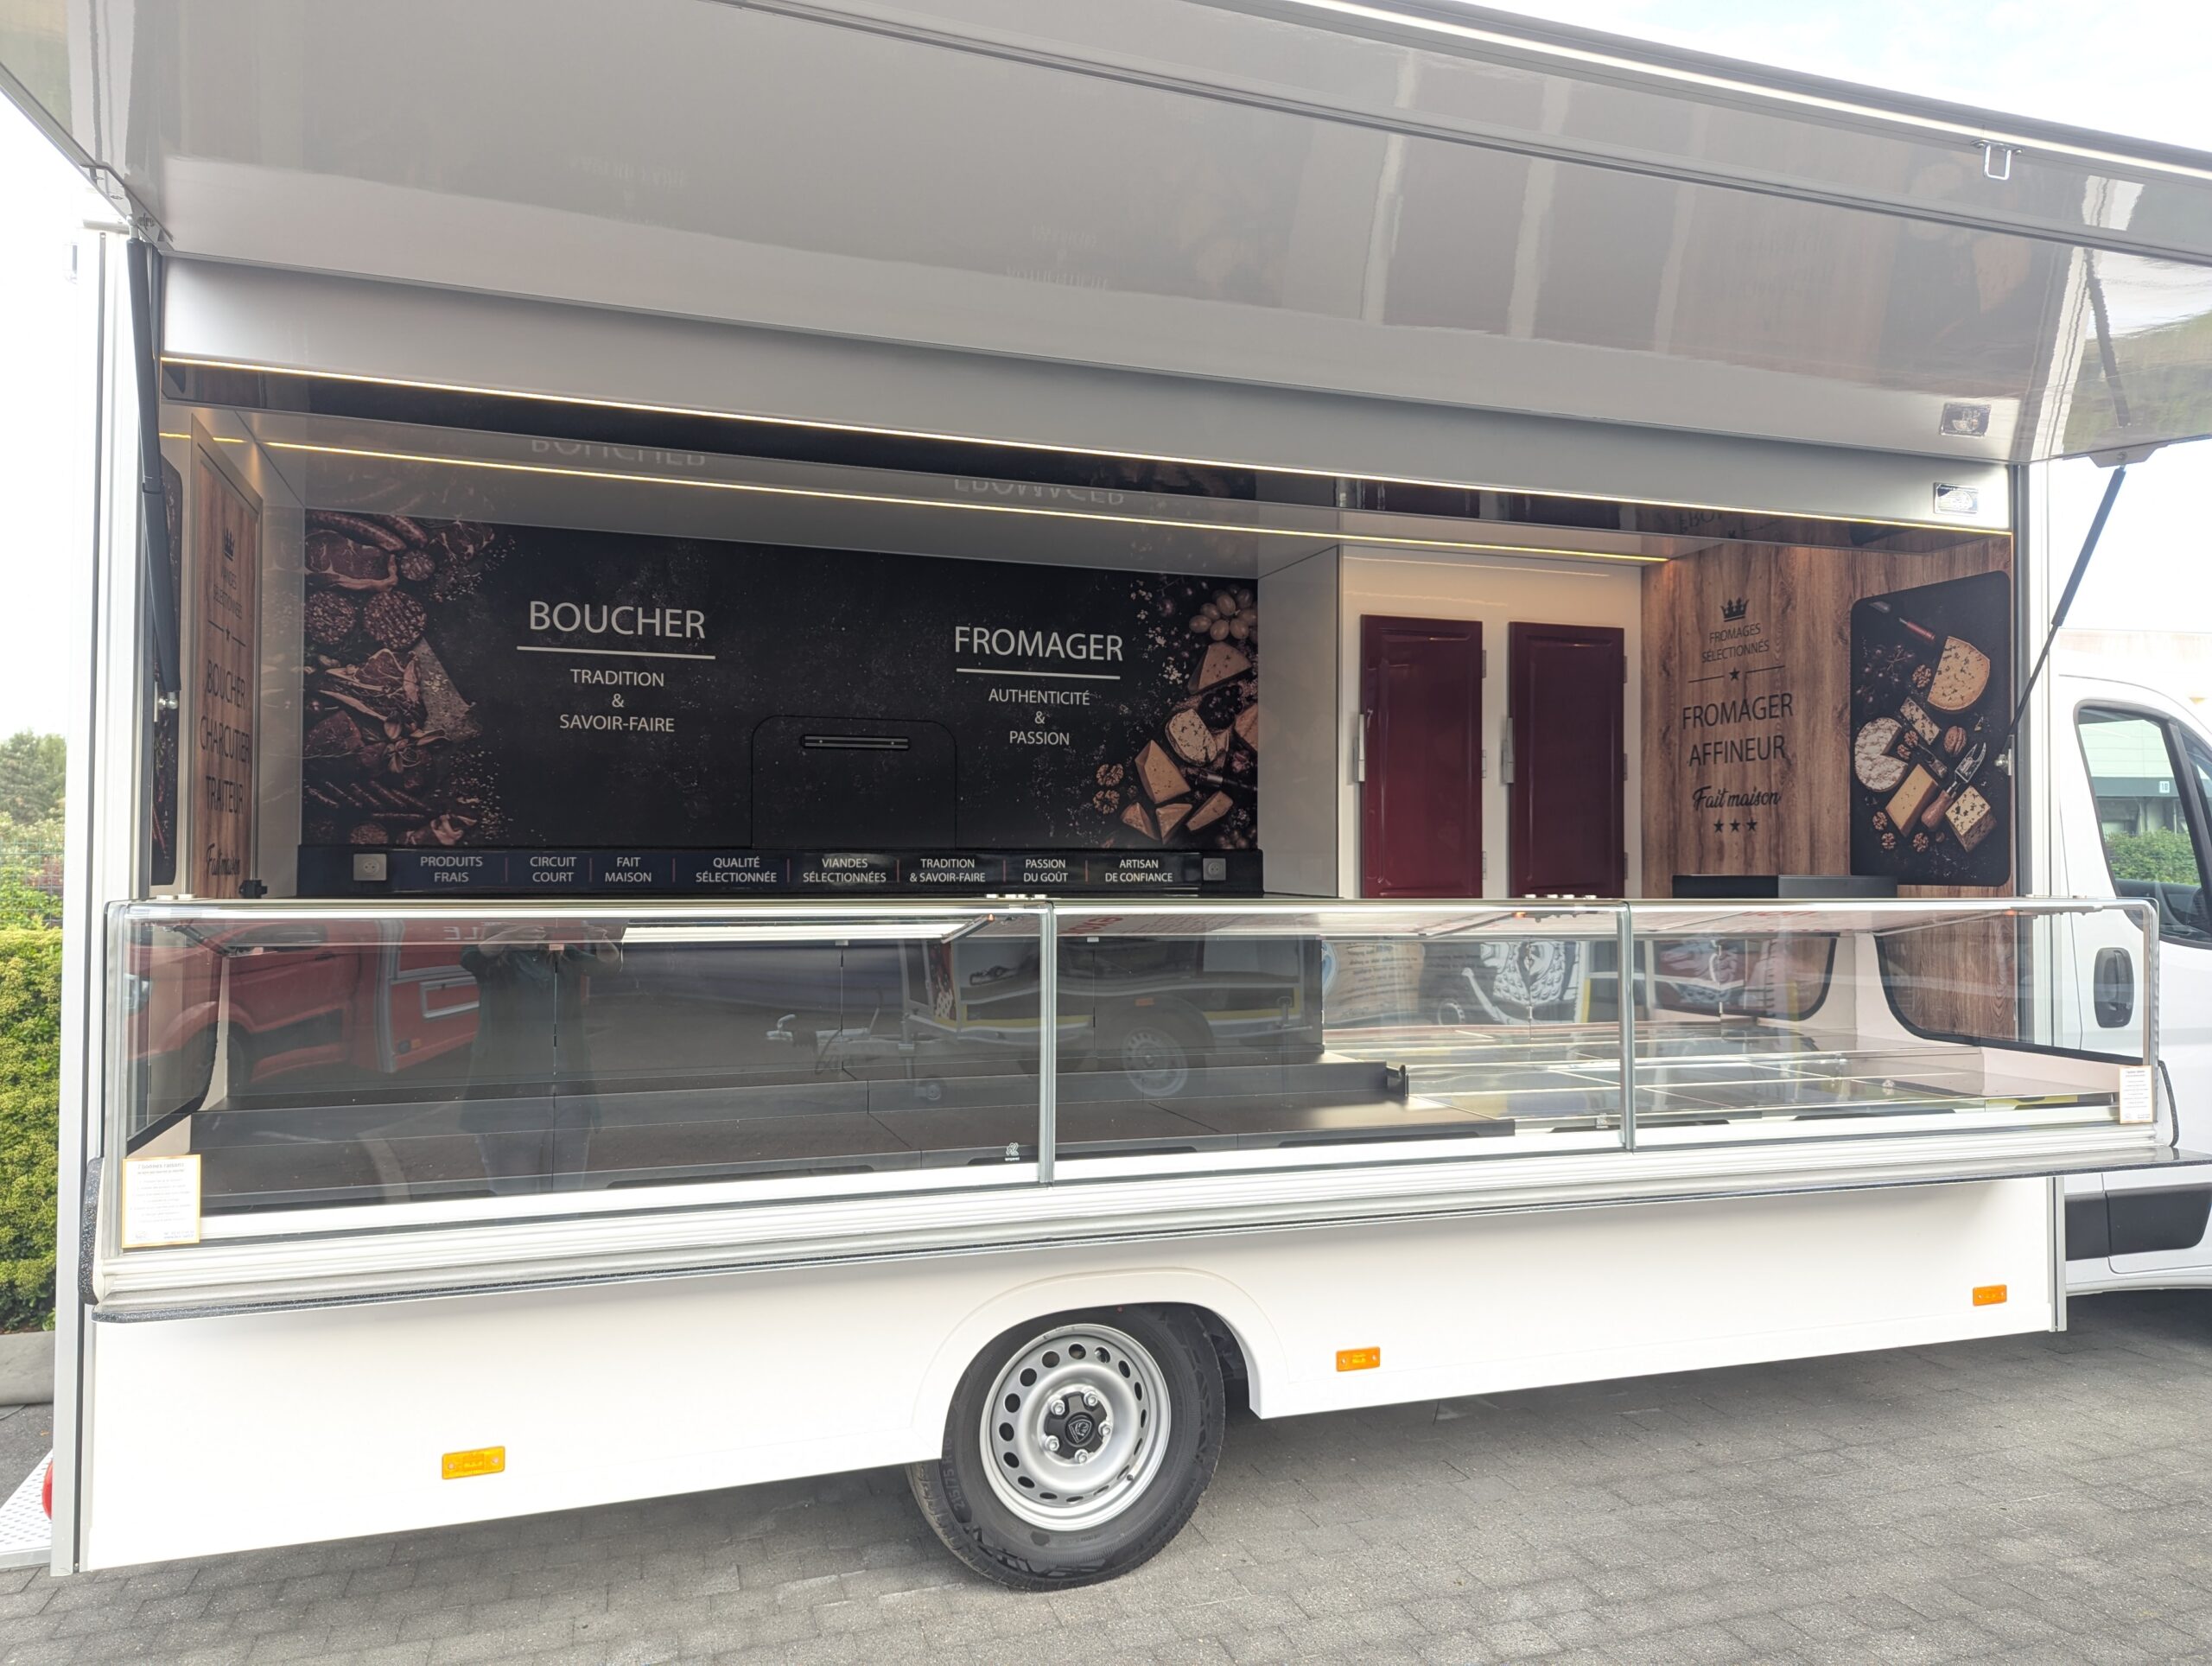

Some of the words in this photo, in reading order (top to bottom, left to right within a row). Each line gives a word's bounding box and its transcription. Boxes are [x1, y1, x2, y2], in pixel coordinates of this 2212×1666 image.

[530, 601, 706, 639] BOUCHER
[1709, 622, 1761, 643] FROMAGES
[955, 626, 1123, 662] FROMAGER
[1701, 639, 1770, 664] SÉLECTIONNÉS
[207, 658, 245, 709] BOUCHER
[569, 668, 664, 687] TRADITION
[611, 693, 625, 708] &
[988, 688, 1090, 706] AUTHENTICITÉ
[1034, 710, 1046, 724] &
[1682, 692, 1794, 730] FROMAGER
[559, 714, 675, 733] SAVOIR-FAIRE
[200, 715, 250, 764] CHARCUTIER
[1009, 730, 1070, 746] PASSION
[1688, 734, 1786, 767] AFFINEUR
[1693, 785, 1729, 811] Fait
[1729, 785, 1781, 809] maison
[420, 855, 483, 868] PRODUITS
[530, 856, 577, 868] CIRCUIT
[616, 856, 641, 868] FAIT
[713, 855, 760, 868] QUALITÉ
[822, 858, 868, 868] VIANDES
[920, 858, 975, 868] TRADITION
[1025, 859, 1066, 869] PASSION
[1119, 859, 1159, 869] ARTISAN
[434, 871, 469, 883] FRAIS
[532, 871, 575, 882] COURT
[605, 872, 652, 882] MAISON
[696, 870, 777, 883] SÉLECTIONNÉE
[803, 870, 887, 883] SÉLECTIONNÉES
[909, 872, 918, 882] &
[919, 872, 986, 882] SAVOIR-FAIRE
[1023, 872, 1039, 882] DU
[1039, 869, 1069, 882] GOÛT
[1105, 872, 1118, 882] DE
[1121, 872, 1173, 882] CONFIANCE
